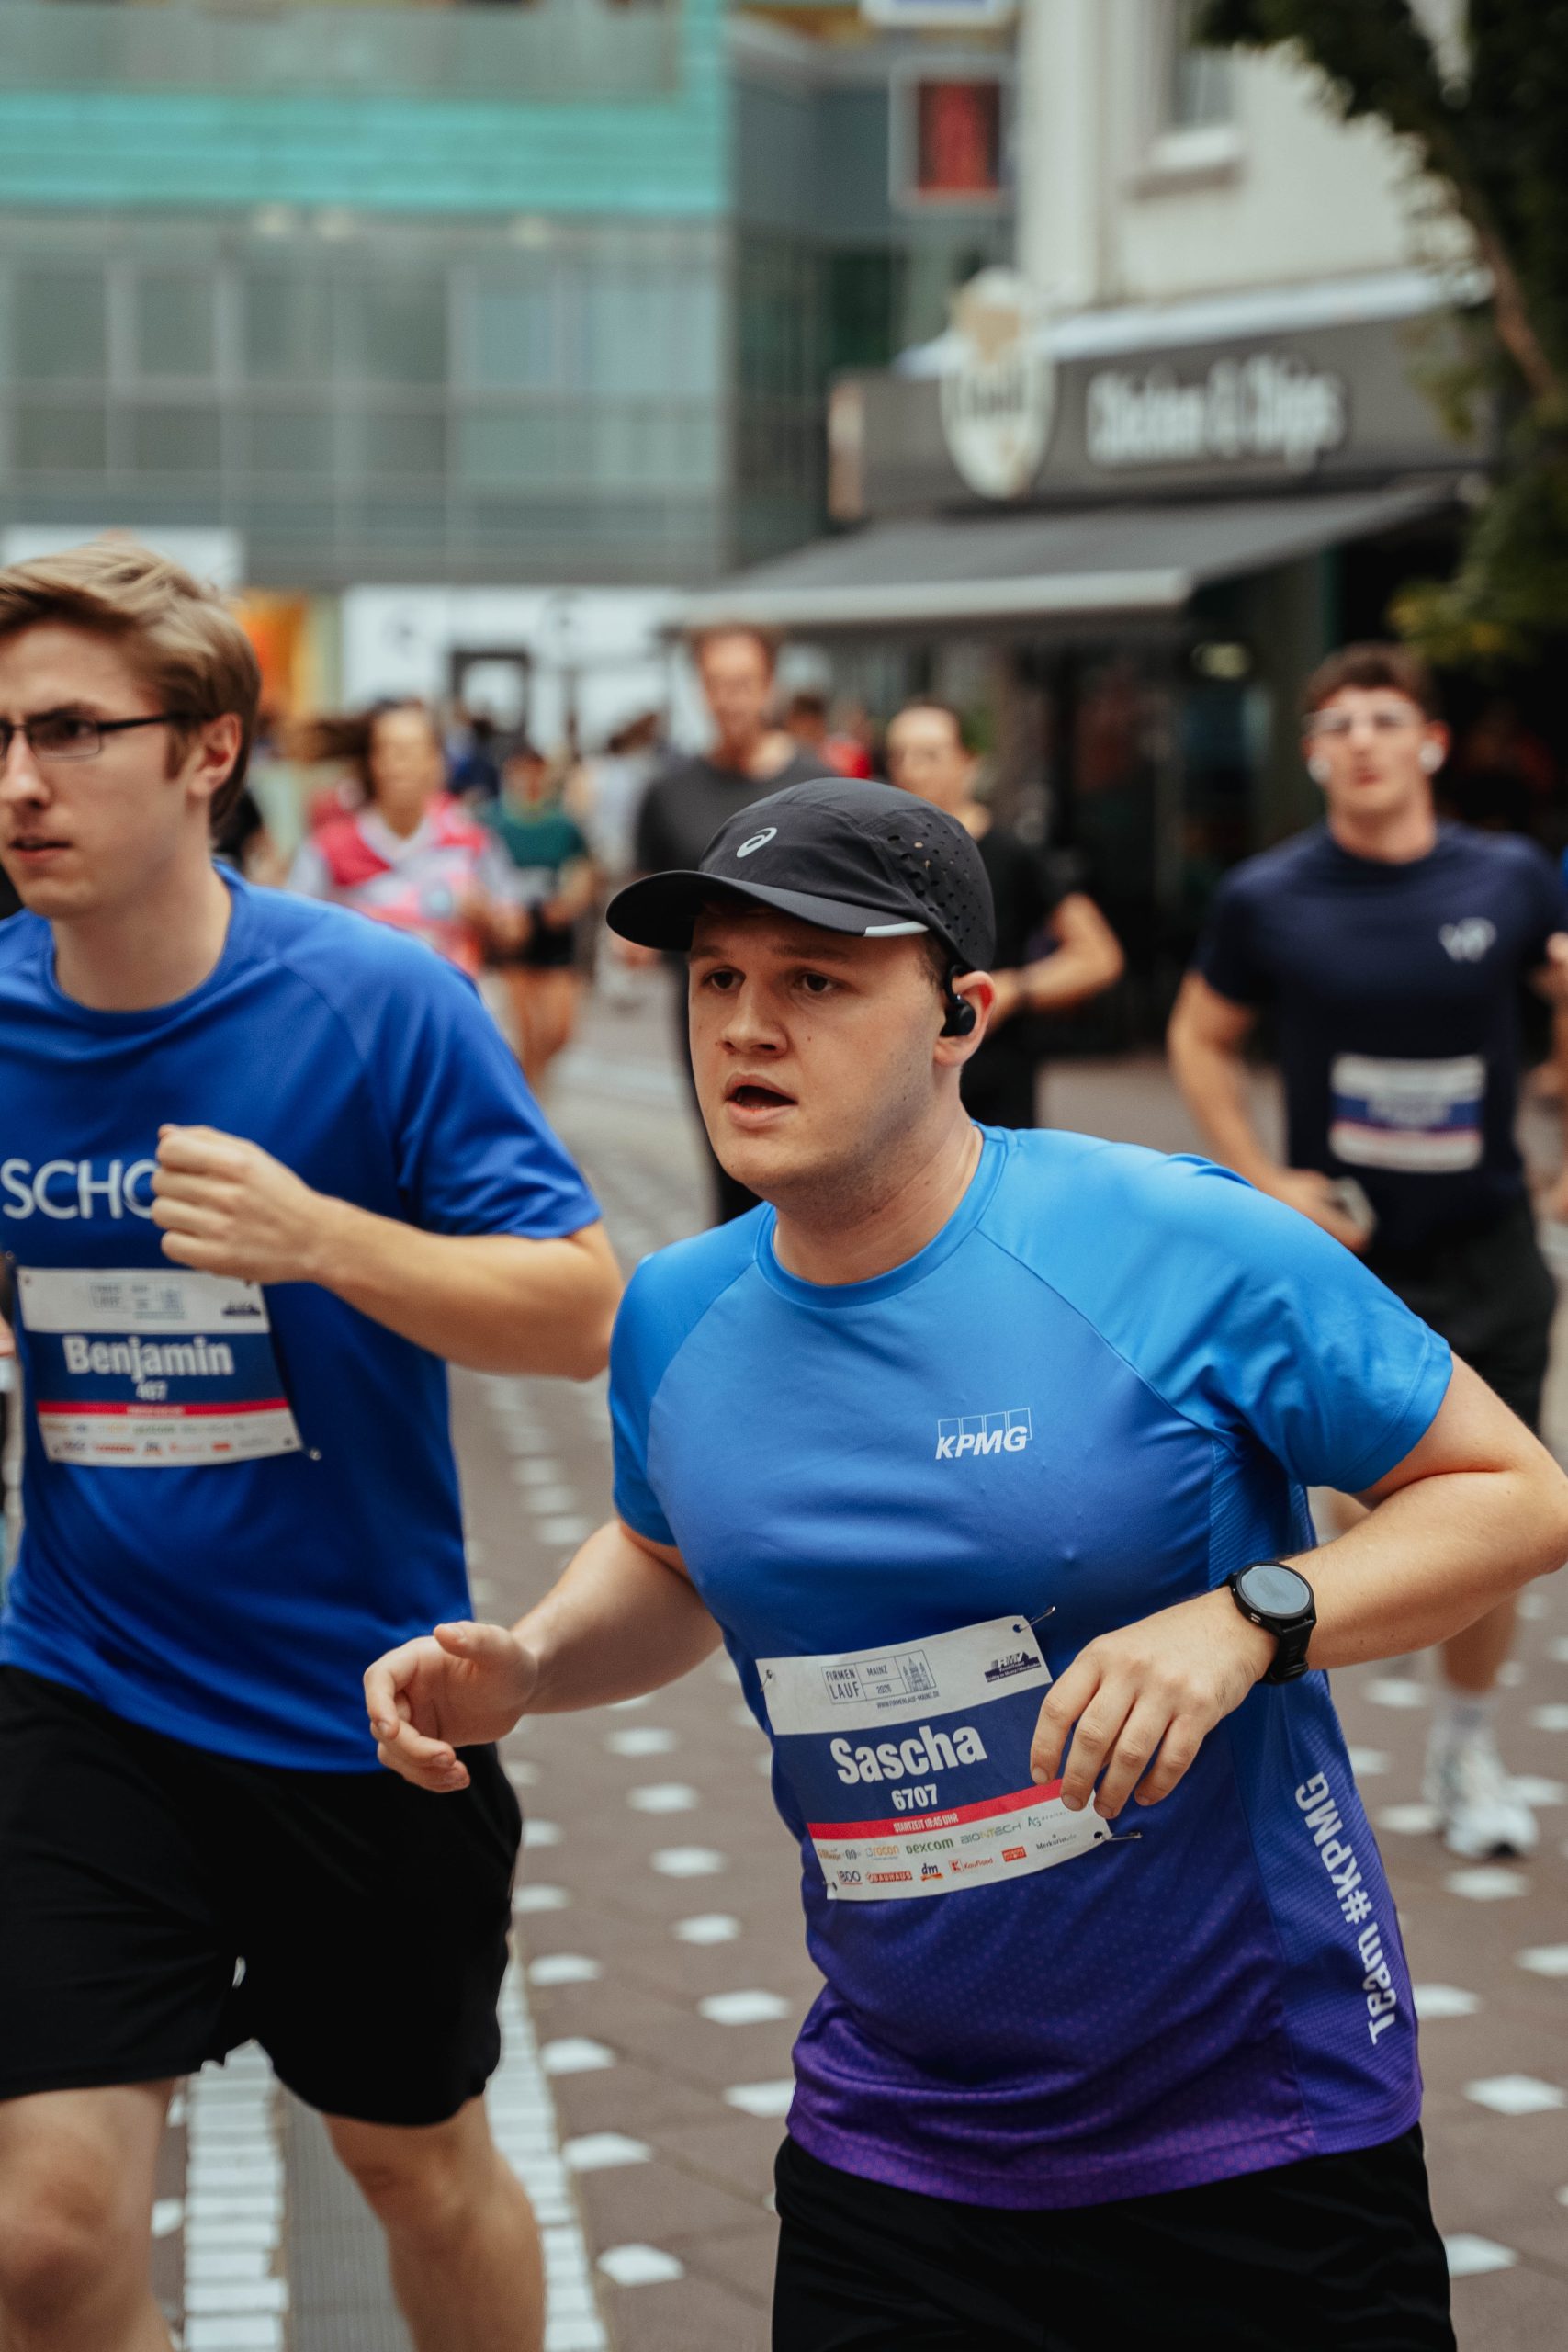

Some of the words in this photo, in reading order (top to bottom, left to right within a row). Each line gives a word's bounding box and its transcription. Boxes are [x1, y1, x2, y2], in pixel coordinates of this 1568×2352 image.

[62, 1335, 234, 1382] Benjamin
[935, 1426, 1028, 1460] KPMG
[826, 1668, 856, 1682] FIRMEN
[866, 1665, 888, 1677] MAINZ
[829, 1681, 860, 1700] LAUF
[830, 1725, 988, 1784] Sascha
[891, 1783, 938, 1811] 6707
[942, 1813, 959, 1826] UHR
[1294, 1770, 1372, 1925] #KPMG
[921, 1863, 939, 1875] dm
[964, 1858, 994, 1871] Kaufland
[1357, 1922, 1397, 2045] Team
